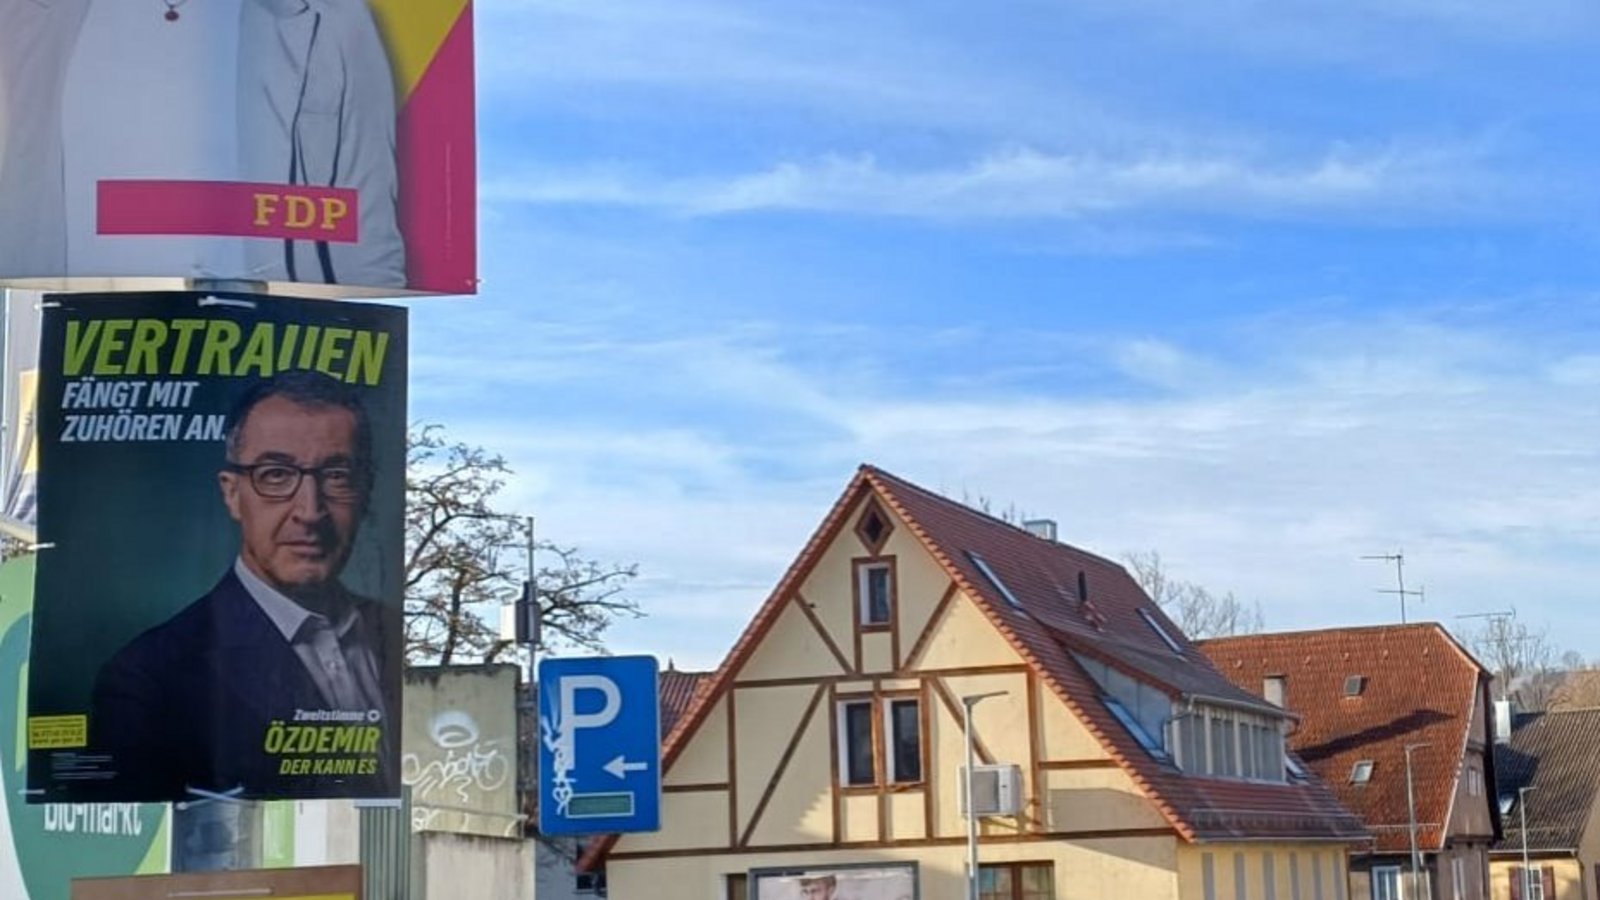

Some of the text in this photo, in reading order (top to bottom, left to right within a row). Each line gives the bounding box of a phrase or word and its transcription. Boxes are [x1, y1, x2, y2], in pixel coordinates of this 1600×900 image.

[253, 193, 348, 230] FDP
[62, 318, 389, 386] VERTRAUEN
[61, 376, 199, 409] FÄNGT MIT
[60, 408, 226, 442] ZUHÖREN AN.
[293, 709, 365, 721] Zweitstimme
[560, 675, 622, 770] P
[264, 720, 380, 754] ÖZDEMIR
[279, 759, 378, 775] DER KANN ES
